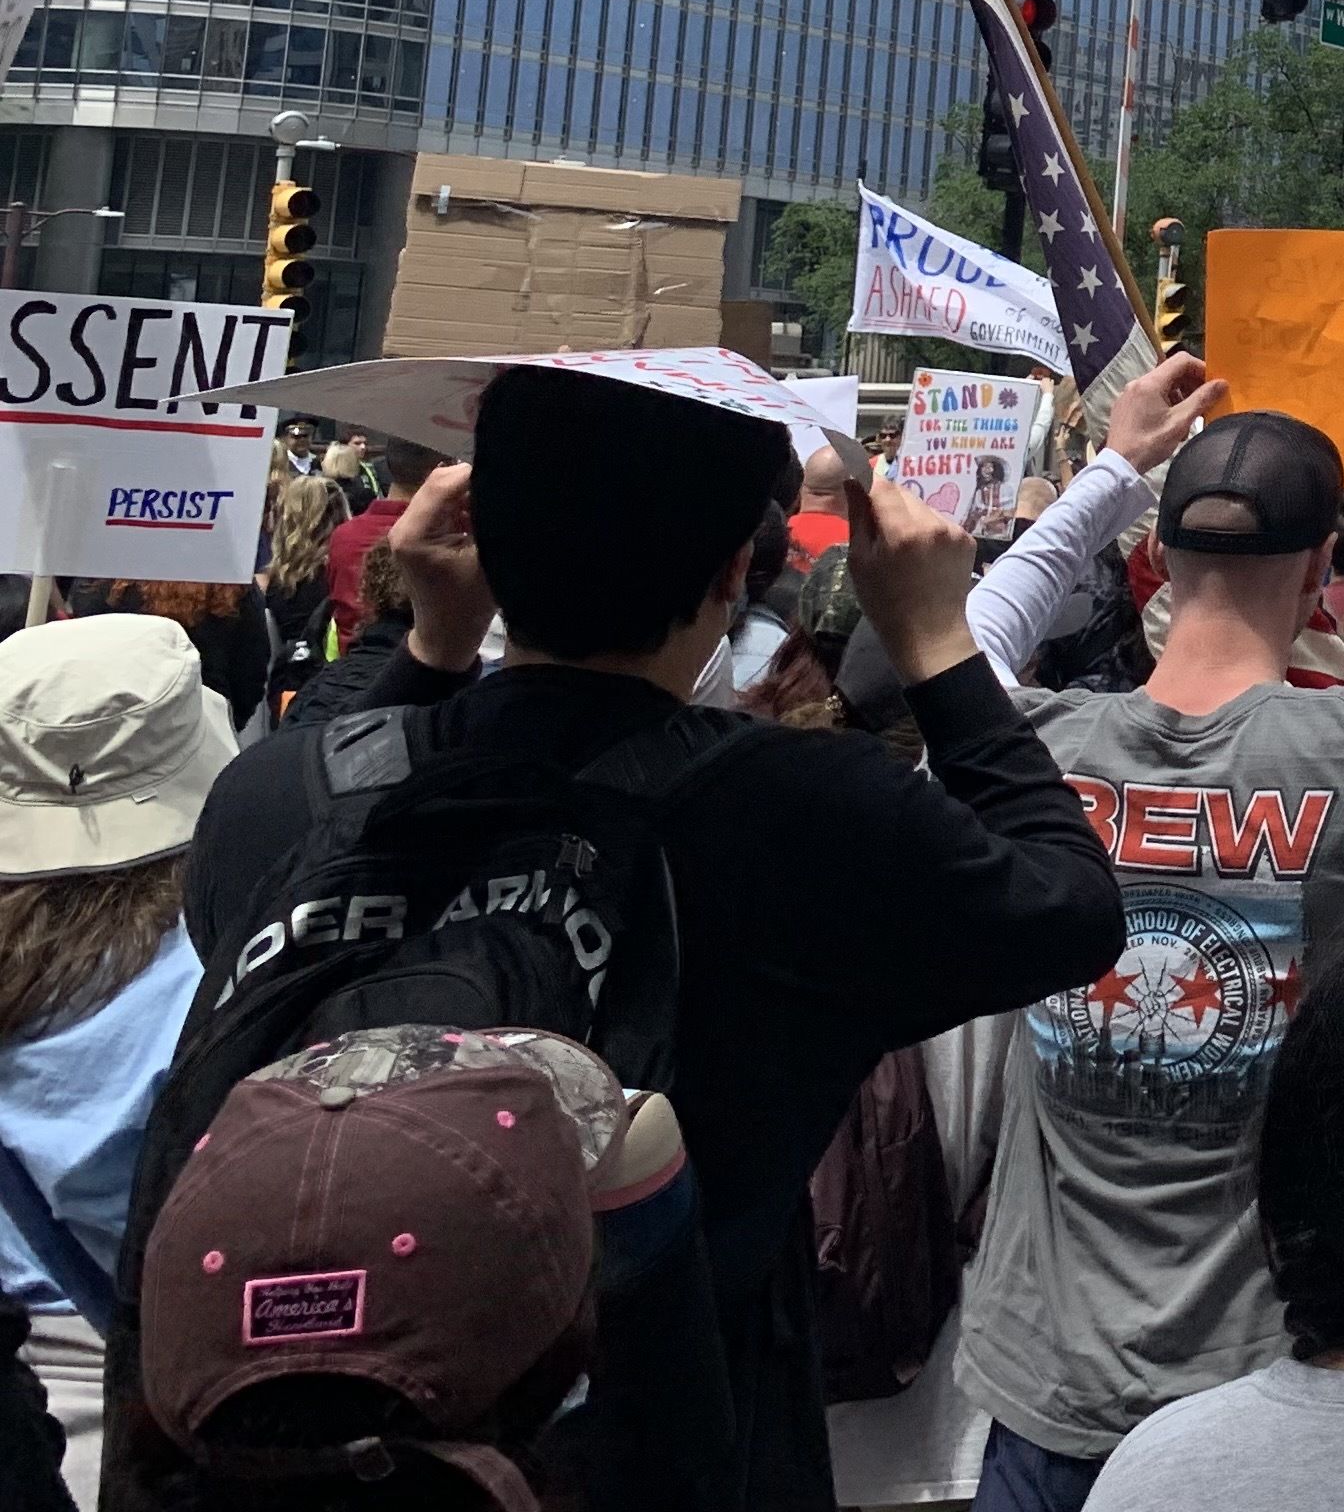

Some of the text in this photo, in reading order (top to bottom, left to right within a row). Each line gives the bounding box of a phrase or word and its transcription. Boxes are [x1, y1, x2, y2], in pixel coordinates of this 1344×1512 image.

[1326, 8, 1335, 21] W
[970, 320, 1061, 360] GOVERNMENT
[0, 300, 292, 420] SSENT
[913, 382, 994, 416] STAND
[919, 417, 1019, 433] FOR THE THINGS
[926, 437, 1015, 451] YOU KNOW ARE
[901, 453, 972, 478] RIGHT!
[107, 487, 234, 520] PERSIST
[1181, 918, 1207, 942] OF
[1199, 931, 1244, 1028] ELECTRICAL
